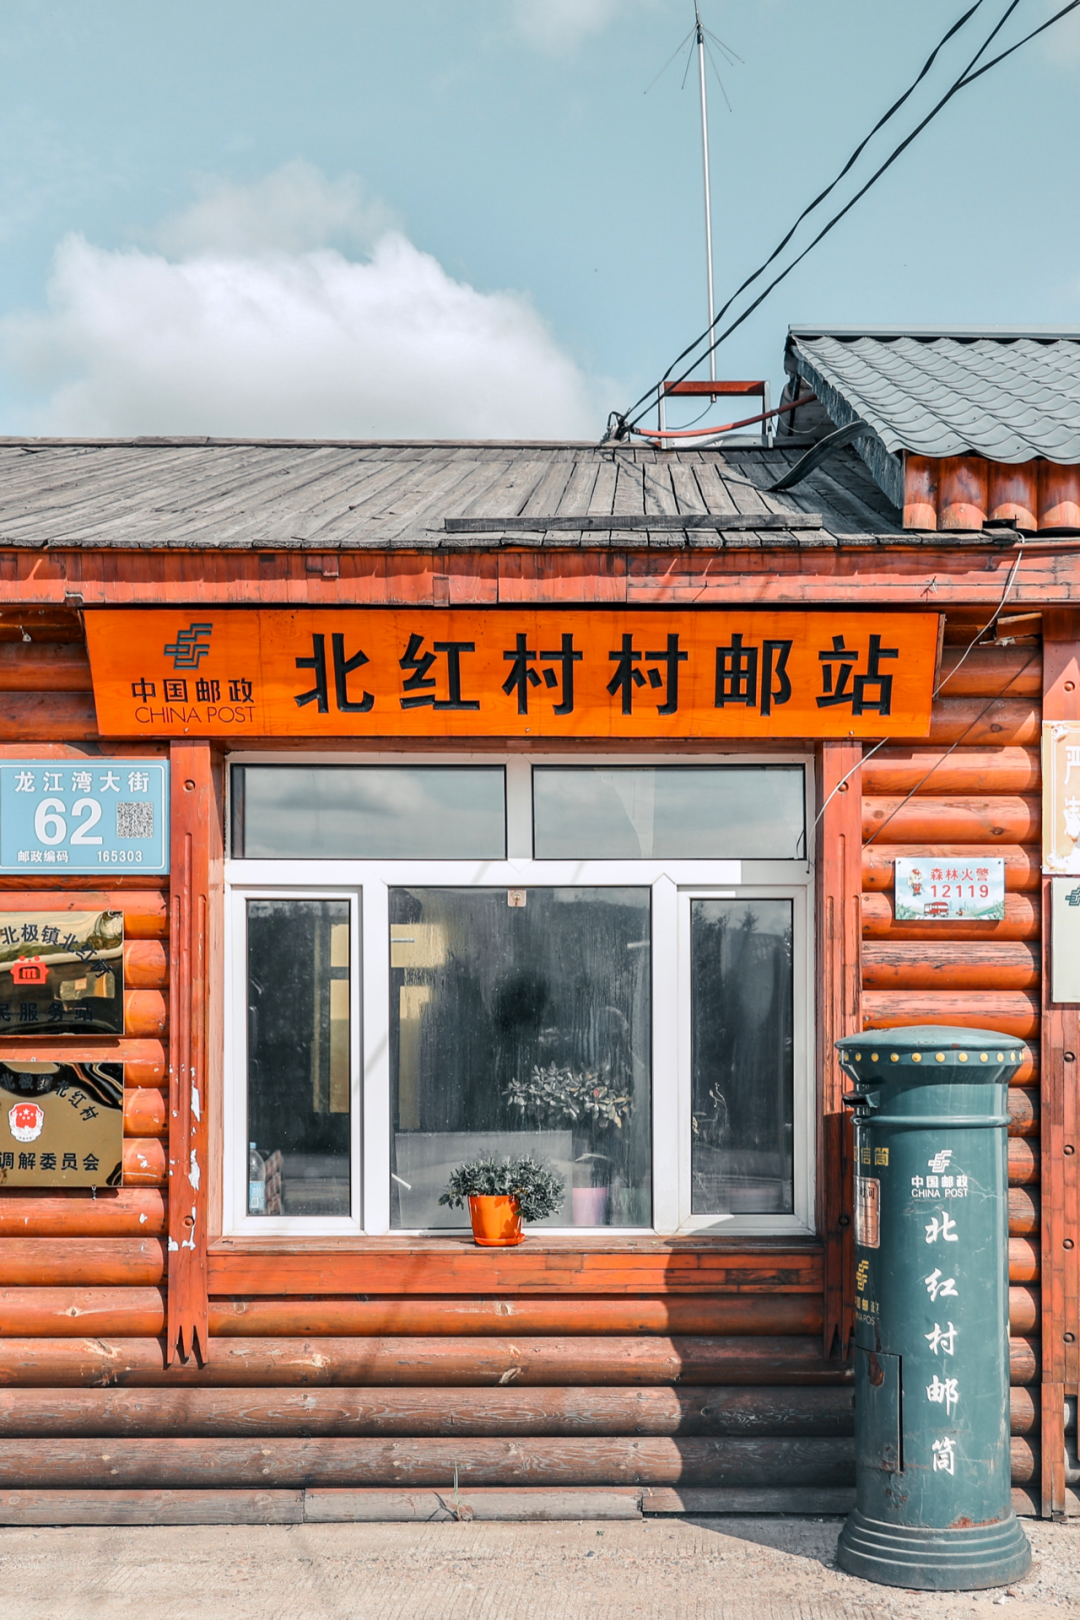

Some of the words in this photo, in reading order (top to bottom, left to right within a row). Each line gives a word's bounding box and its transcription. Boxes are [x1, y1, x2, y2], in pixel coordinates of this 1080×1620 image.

[293, 633, 899, 716] 北红村村邮站
[131, 677, 255, 704] 中国邮政
[134, 706, 202, 724] CHINA
[206, 706, 256, 724] POST
[14, 771, 150, 793] 龙江湾大街
[34, 797, 103, 846] 62
[17, 850, 69, 863] 邮政编码
[97, 850, 143, 863] 165303
[930, 867, 989, 882] 森林火警
[930, 884, 989, 898] 12119
[1, 923, 113, 979] 北极镇北红村
[1, 1072, 99, 1122] 北极镇北红村
[0, 1152, 100, 1172] 调解委员会
[911, 1175, 969, 1188] 中国邮政
[911, 1188, 941, 1198] CHINA
[944, 1188, 969, 1198] POST
[924, 1211, 960, 1476] 北红村邮筒
